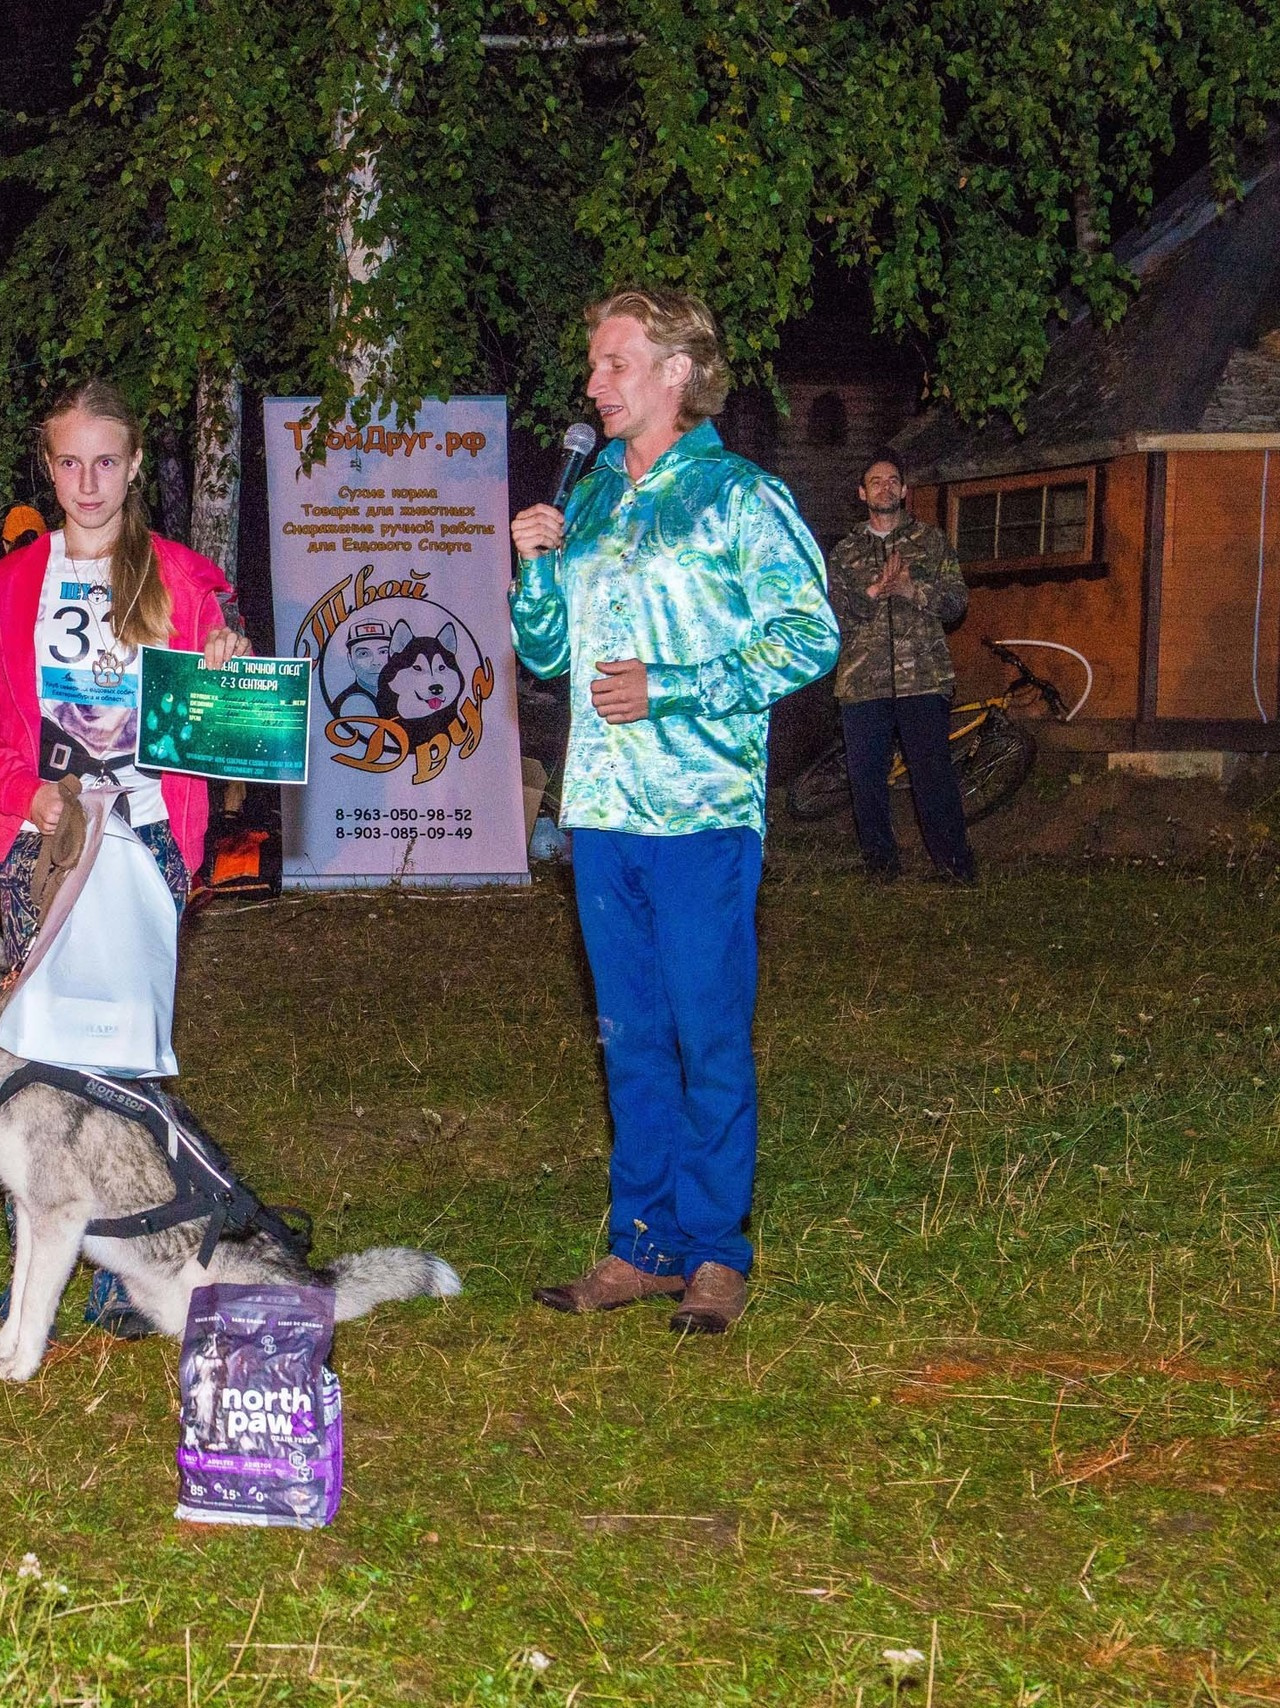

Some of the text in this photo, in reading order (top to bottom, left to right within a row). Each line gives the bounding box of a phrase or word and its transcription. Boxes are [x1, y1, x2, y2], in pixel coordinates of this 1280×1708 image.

[283, 421, 487, 458] ТойДруг.рф
[337, 485, 438, 502] Сухие корма
[300, 503, 476, 520] Товары для животных
[282, 520, 495, 537] Снаряжение ручной работы
[307, 537, 472, 555] для Ездового Спорта
[60, 581, 89, 600] HEY
[293, 564, 432, 670] Твой
[220, 676, 279, 692] 2-3 СЕНТЯБРЯ
[324, 657, 495, 786] Друг
[335, 808, 473, 821] 8-963-050-98-52
[335, 826, 473, 840] 8-903-085-09-49
[86, 1079, 147, 1112] Non-stop
[222, 1386, 313, 1413] north
[227, 1409, 294, 1439] paw
